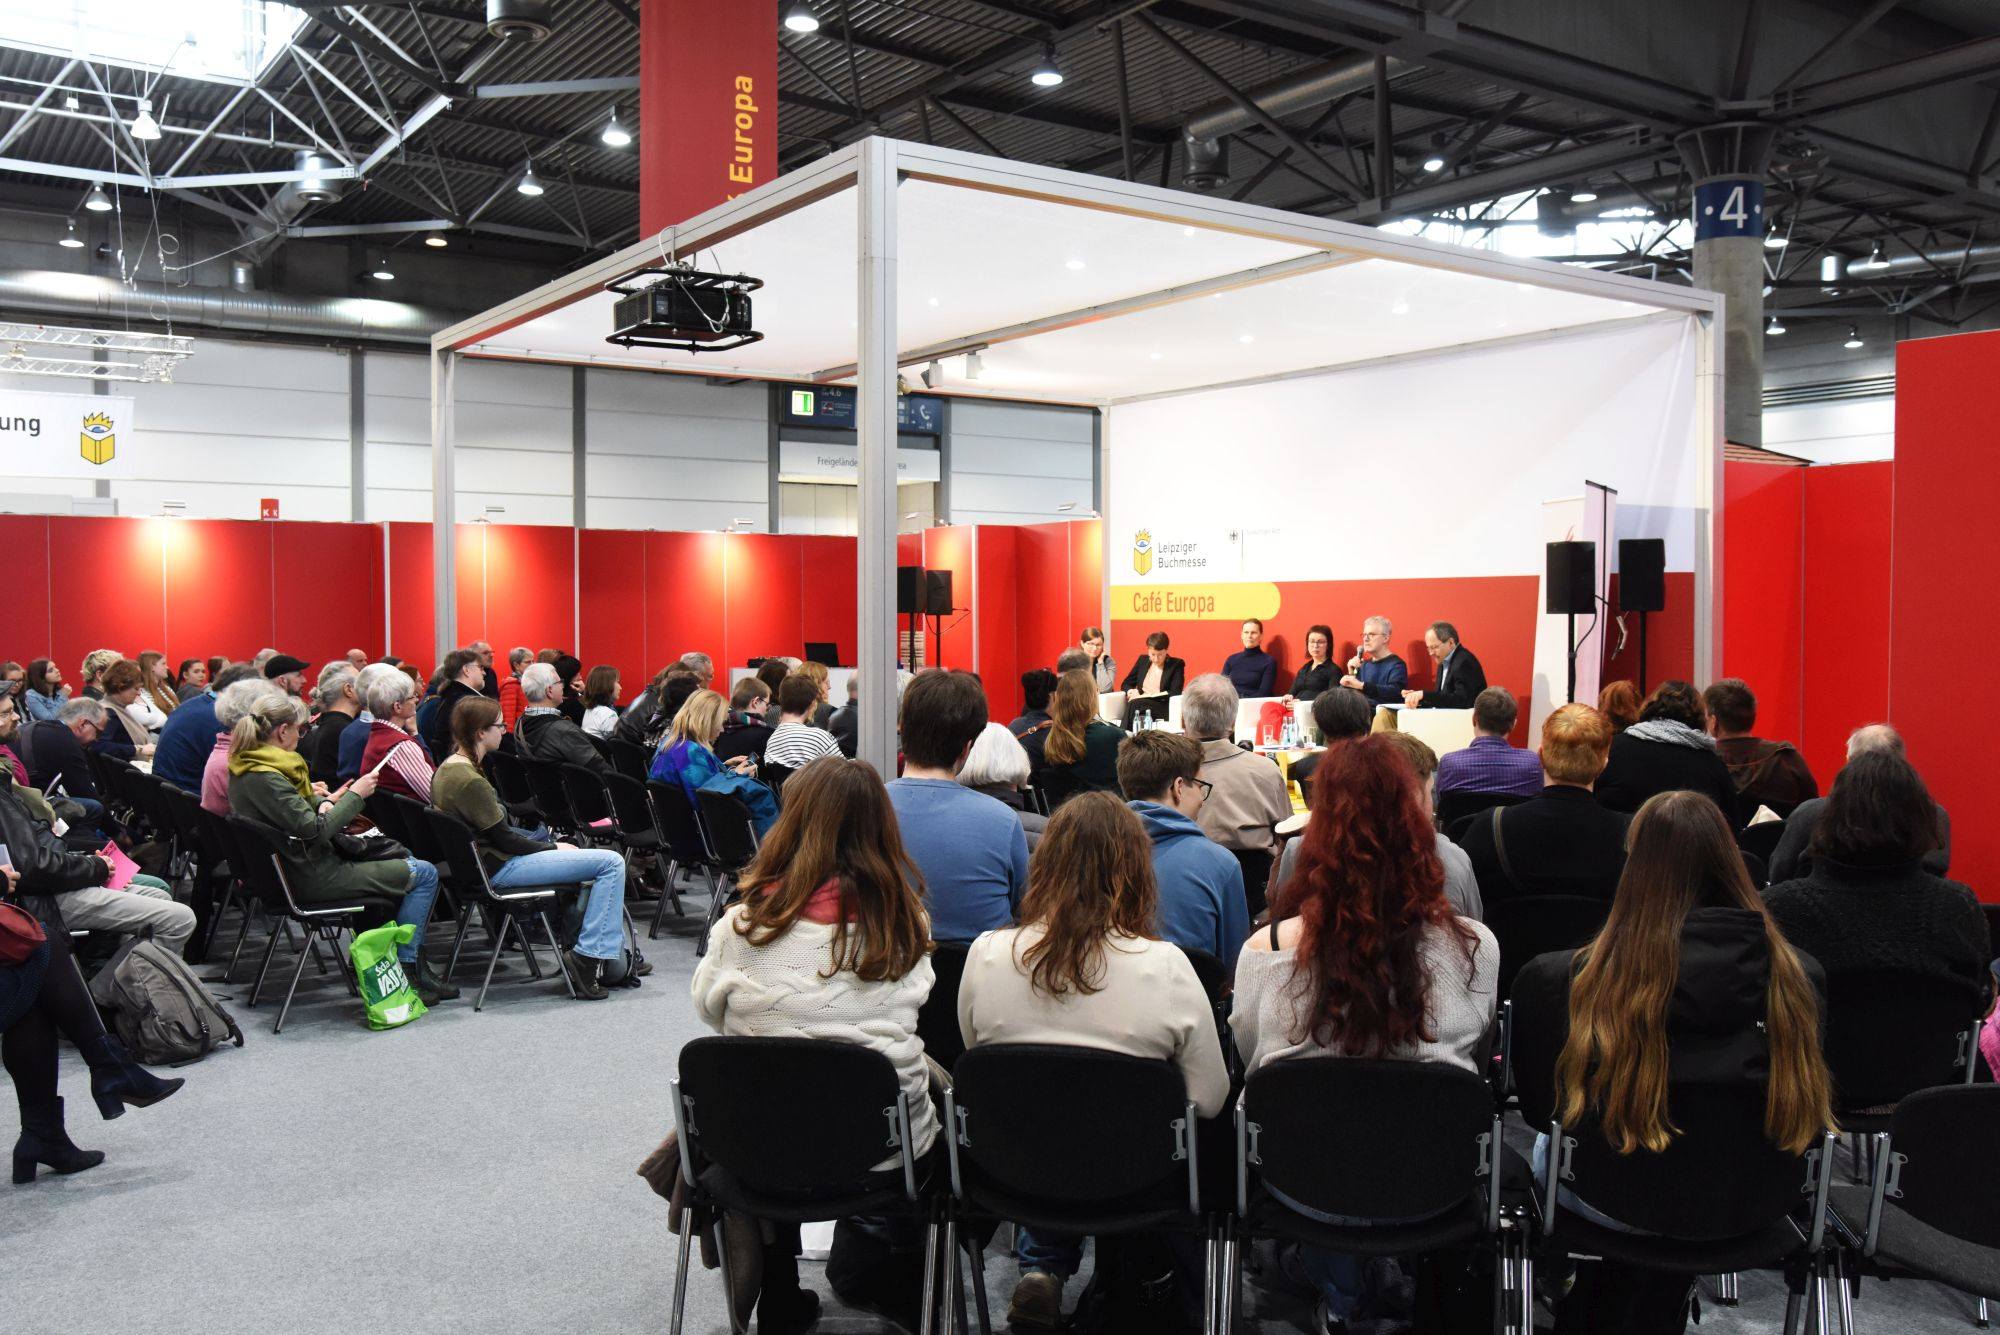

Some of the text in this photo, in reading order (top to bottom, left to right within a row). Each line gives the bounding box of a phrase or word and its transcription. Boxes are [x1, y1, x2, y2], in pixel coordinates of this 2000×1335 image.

[729, 75, 759, 184] Europa
[1720, 186, 1748, 229] 4
[1158, 542, 1198, 555] Leipziger
[1158, 556, 1207, 569] Buchmesse
[1133, 591, 1215, 617] Café Europa
